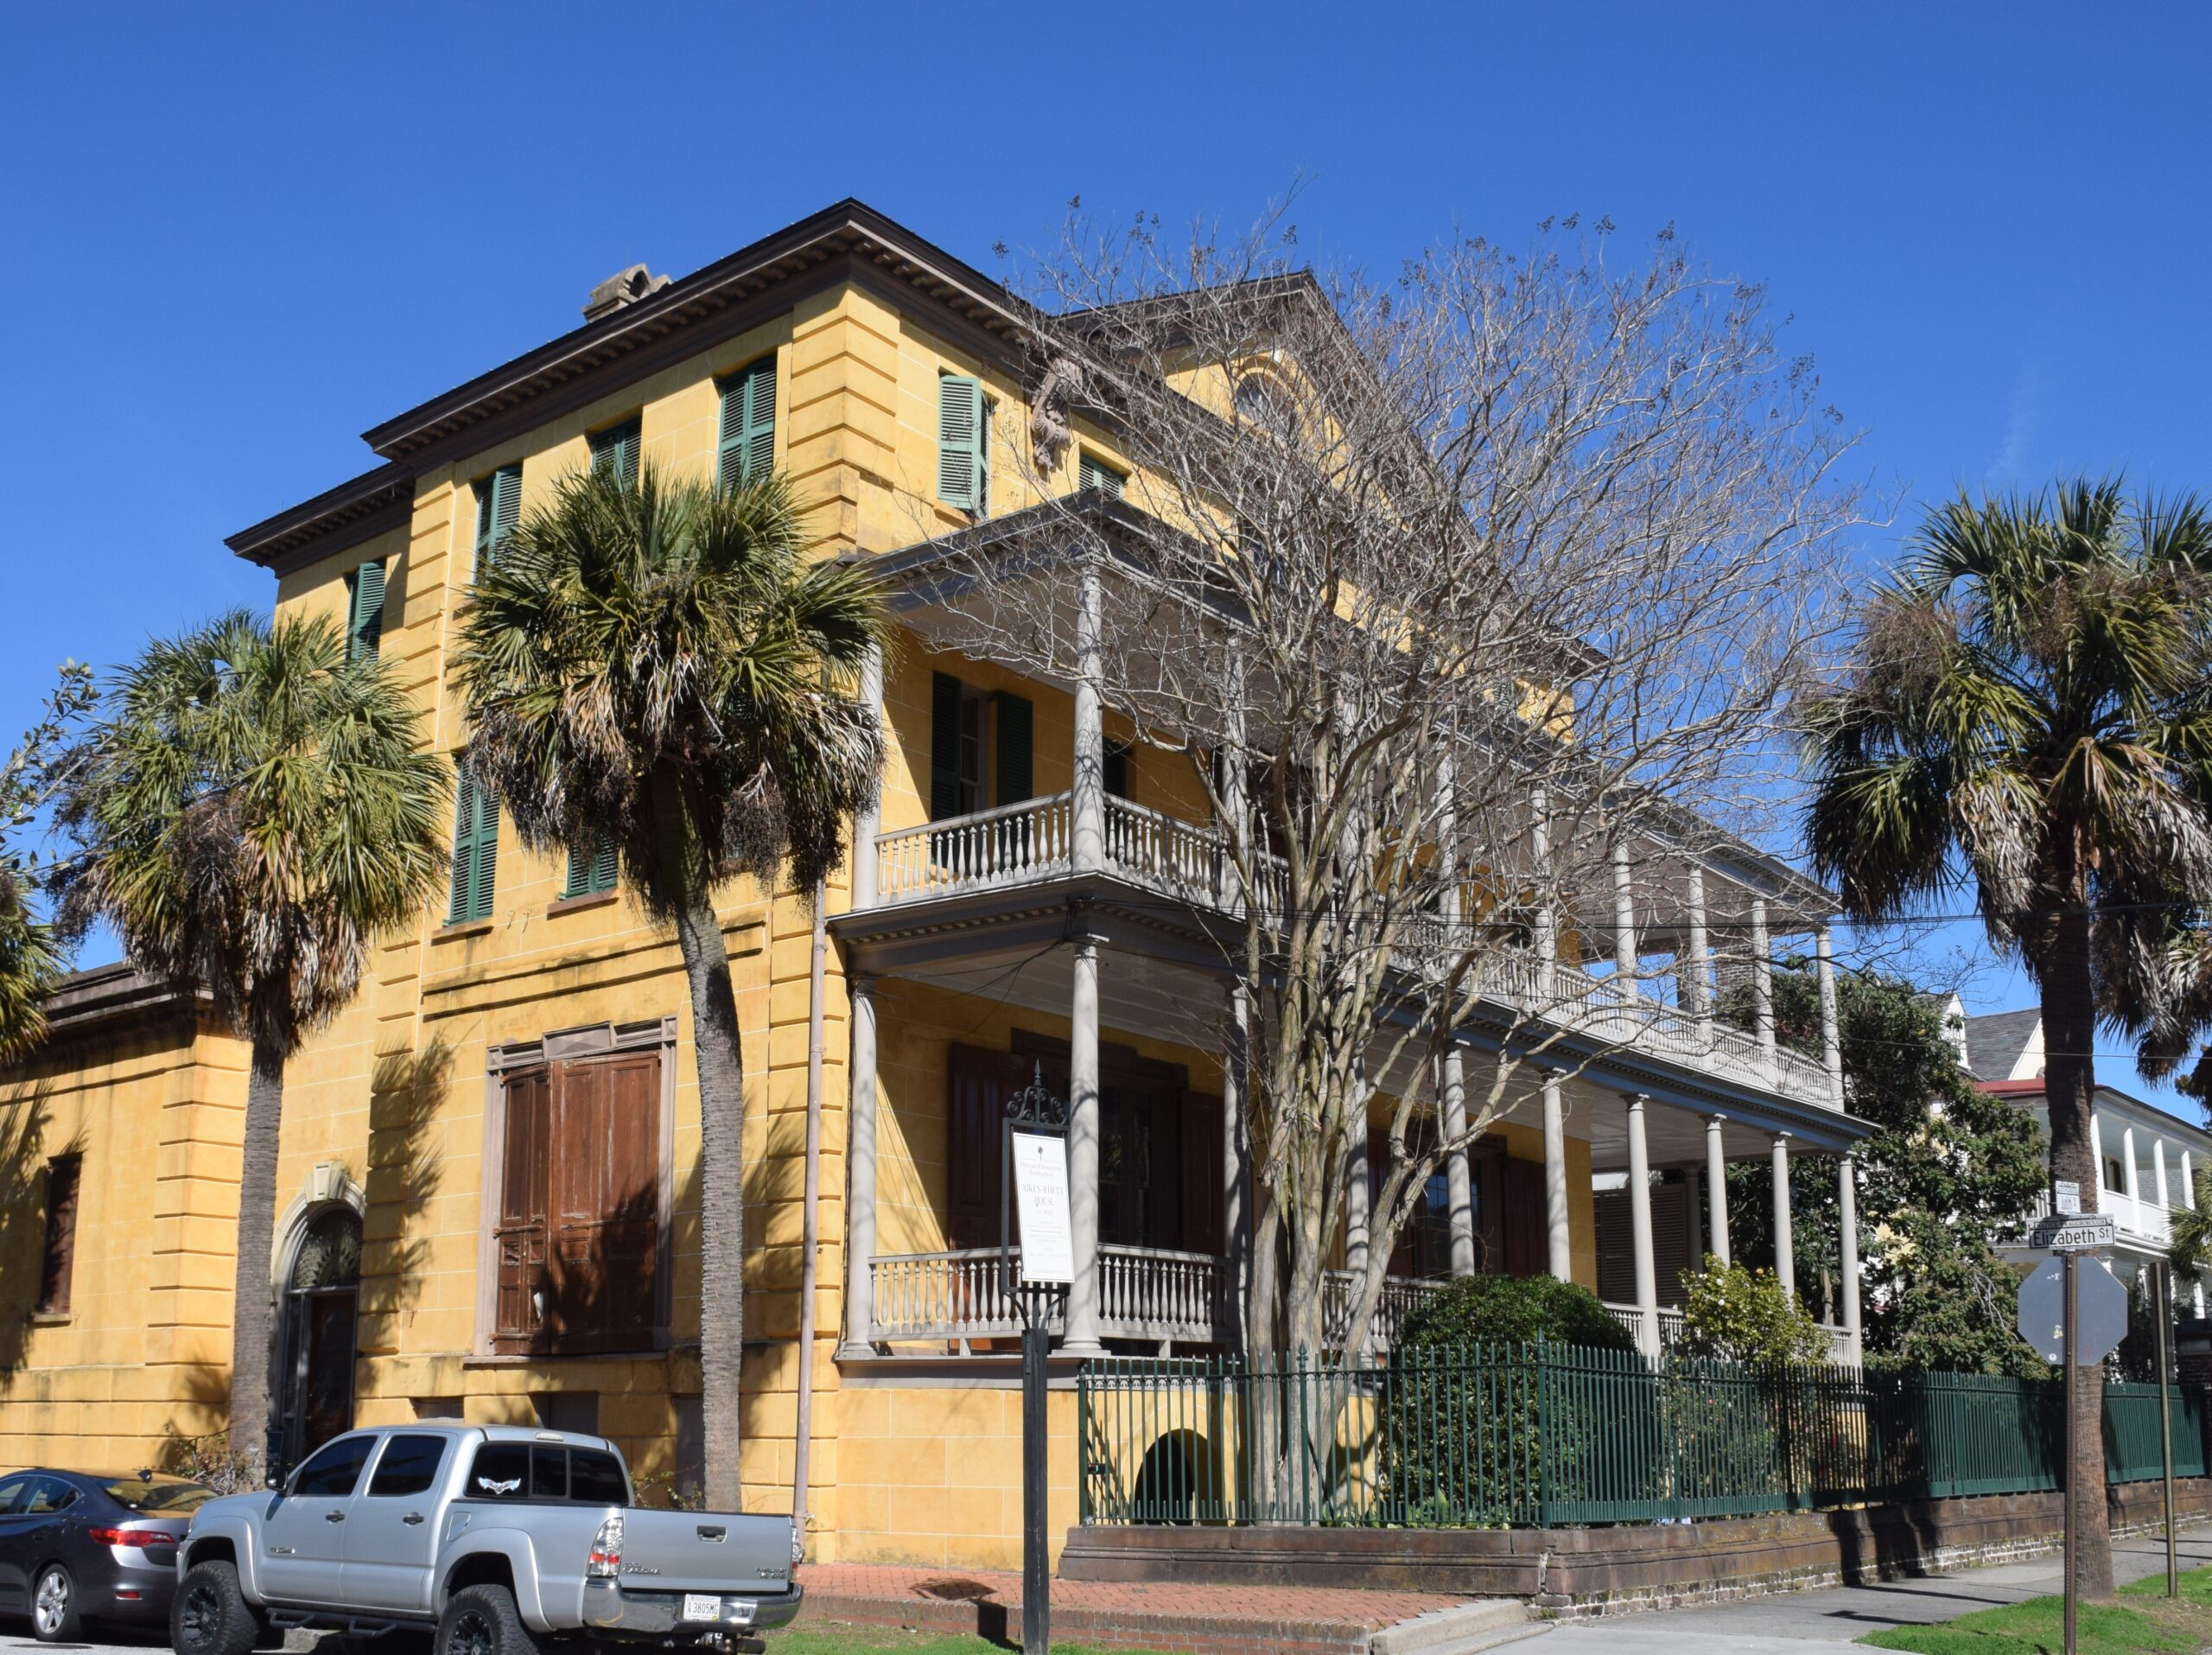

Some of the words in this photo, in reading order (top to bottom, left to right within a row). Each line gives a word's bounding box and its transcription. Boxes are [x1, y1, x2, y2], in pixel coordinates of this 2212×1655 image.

[2033, 1229, 2095, 1246] Elizabeth
[2099, 1227, 2109, 1238] St
[693, 1602, 719, 1615] 3805MG
